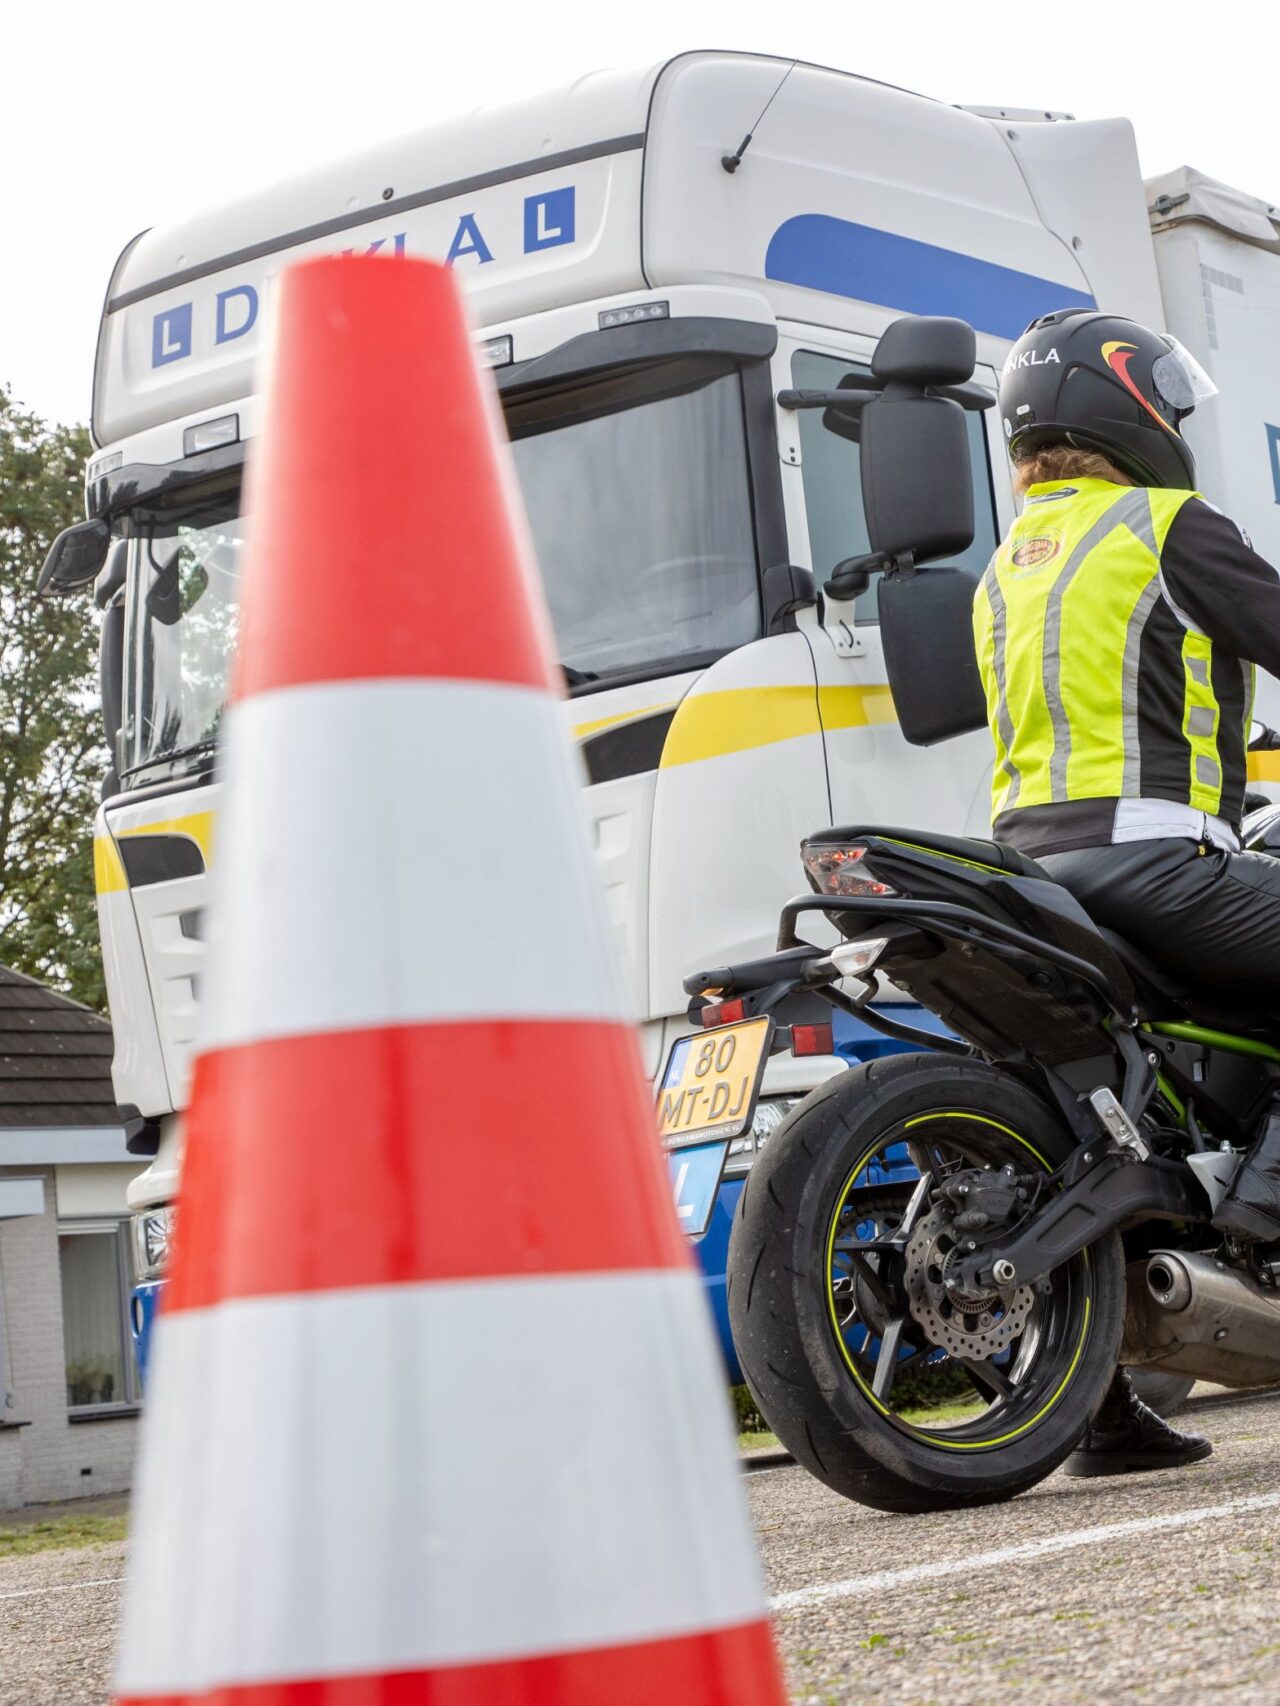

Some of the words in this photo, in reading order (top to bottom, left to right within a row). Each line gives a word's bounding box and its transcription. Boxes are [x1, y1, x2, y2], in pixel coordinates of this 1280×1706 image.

[162, 319, 182, 357] L
[537, 202, 562, 242] L
[1003, 348, 1061, 375] NKLA
[694, 1033, 737, 1078] 80
[659, 1075, 748, 1127] MT-DJ
[674, 1162, 695, 1219] L
